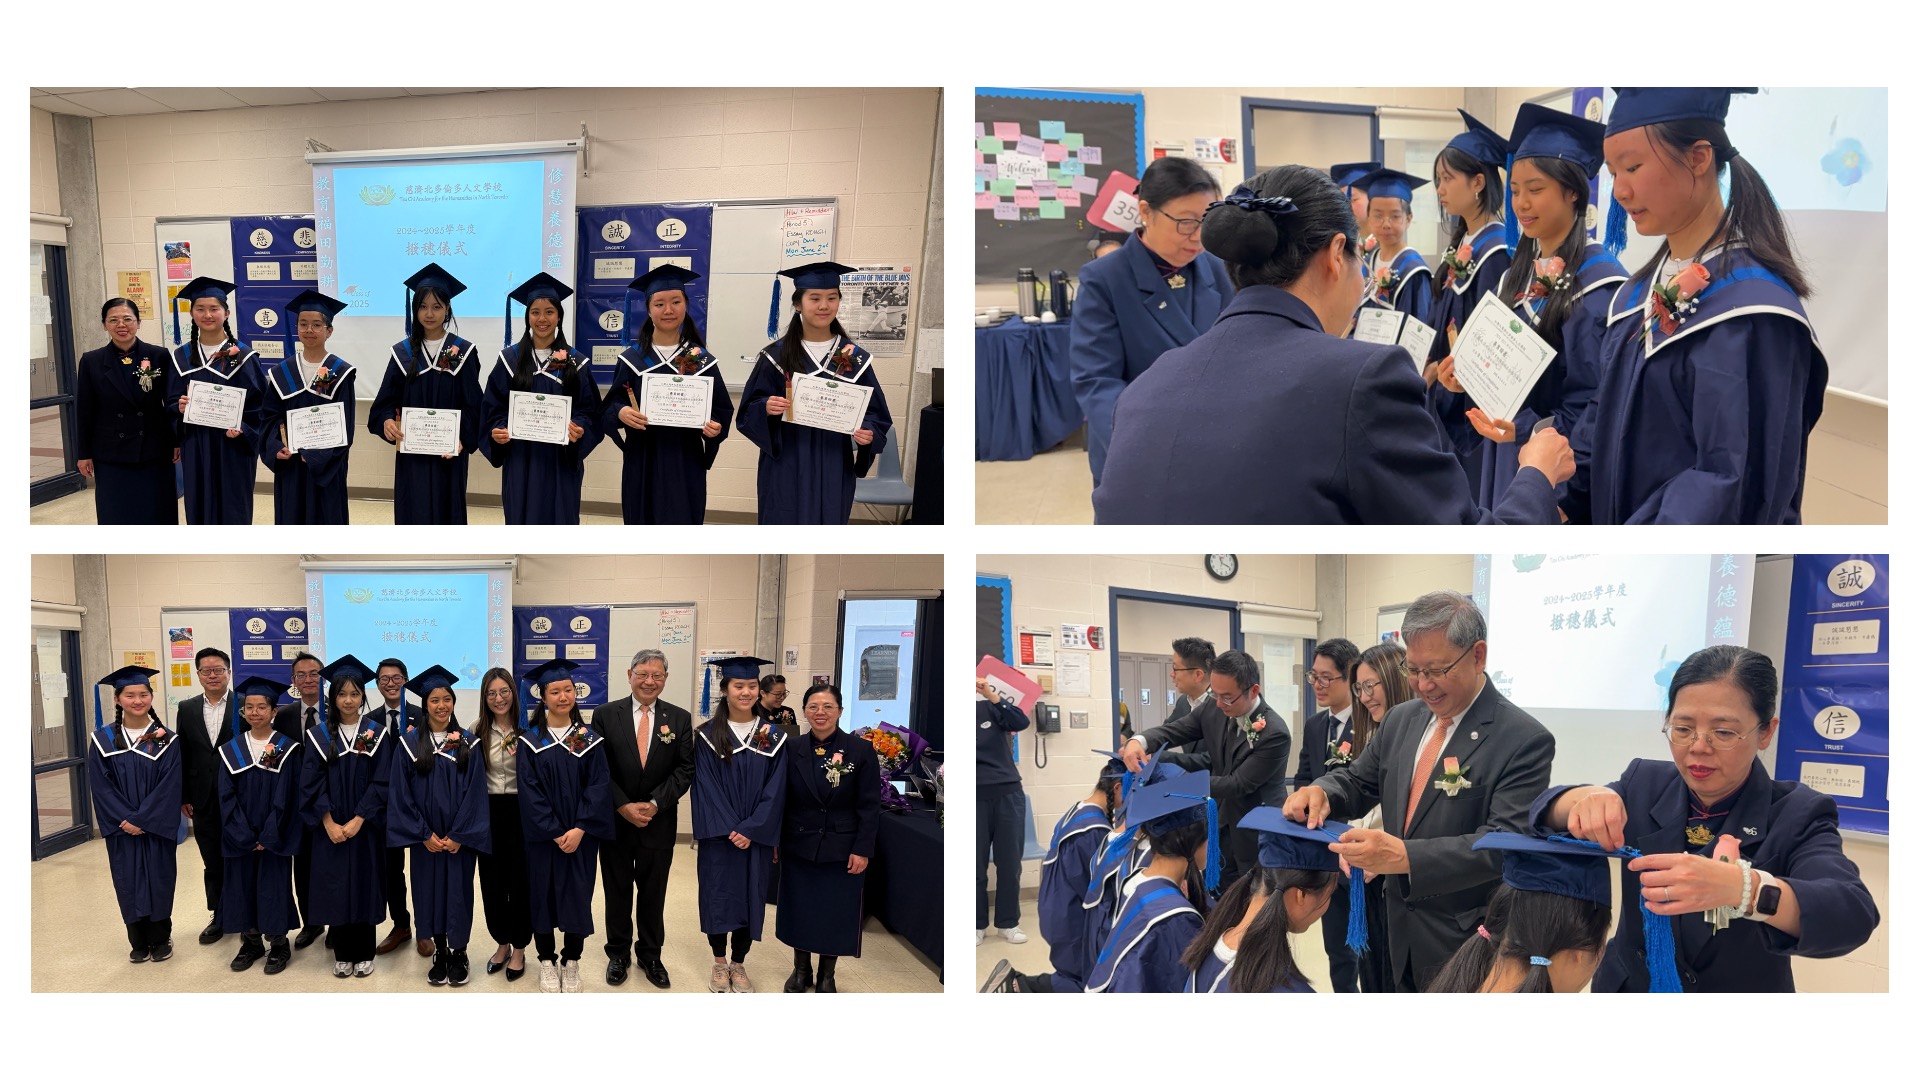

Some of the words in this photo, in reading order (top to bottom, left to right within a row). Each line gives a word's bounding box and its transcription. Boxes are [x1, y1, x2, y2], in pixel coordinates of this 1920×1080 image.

[1007, 162, 1041, 176] Welcome
[405, 182, 503, 195] 慈濟北多倫多人文學校
[300, 229, 312, 246] 悲
[316, 176, 334, 289] 教育福田勤耕
[607, 224, 625, 240] 誠
[662, 223, 680, 238] 正
[787, 231, 803, 239] Essay
[256, 231, 268, 247] 慈
[405, 240, 468, 257] 撥穗儀式
[349, 300, 370, 308] 2025
[260, 310, 273, 326] 喜
[604, 314, 620, 329] 信
[1836, 565, 1864, 590] 誠
[1543, 582, 1628, 605] 2024~2025學年度
[1712, 554, 1740, 639] 養德蘊
[1831, 600, 1865, 609] SINCERITY
[251, 620, 262, 633] 慈
[289, 620, 301, 633] 悲
[309, 580, 322, 659] 教育福田勤
[535, 619, 548, 631] 誠
[574, 619, 587, 630] 正
[1549, 607, 1616, 631] 撥穗儀式
[1822, 711, 1849, 735] 信
